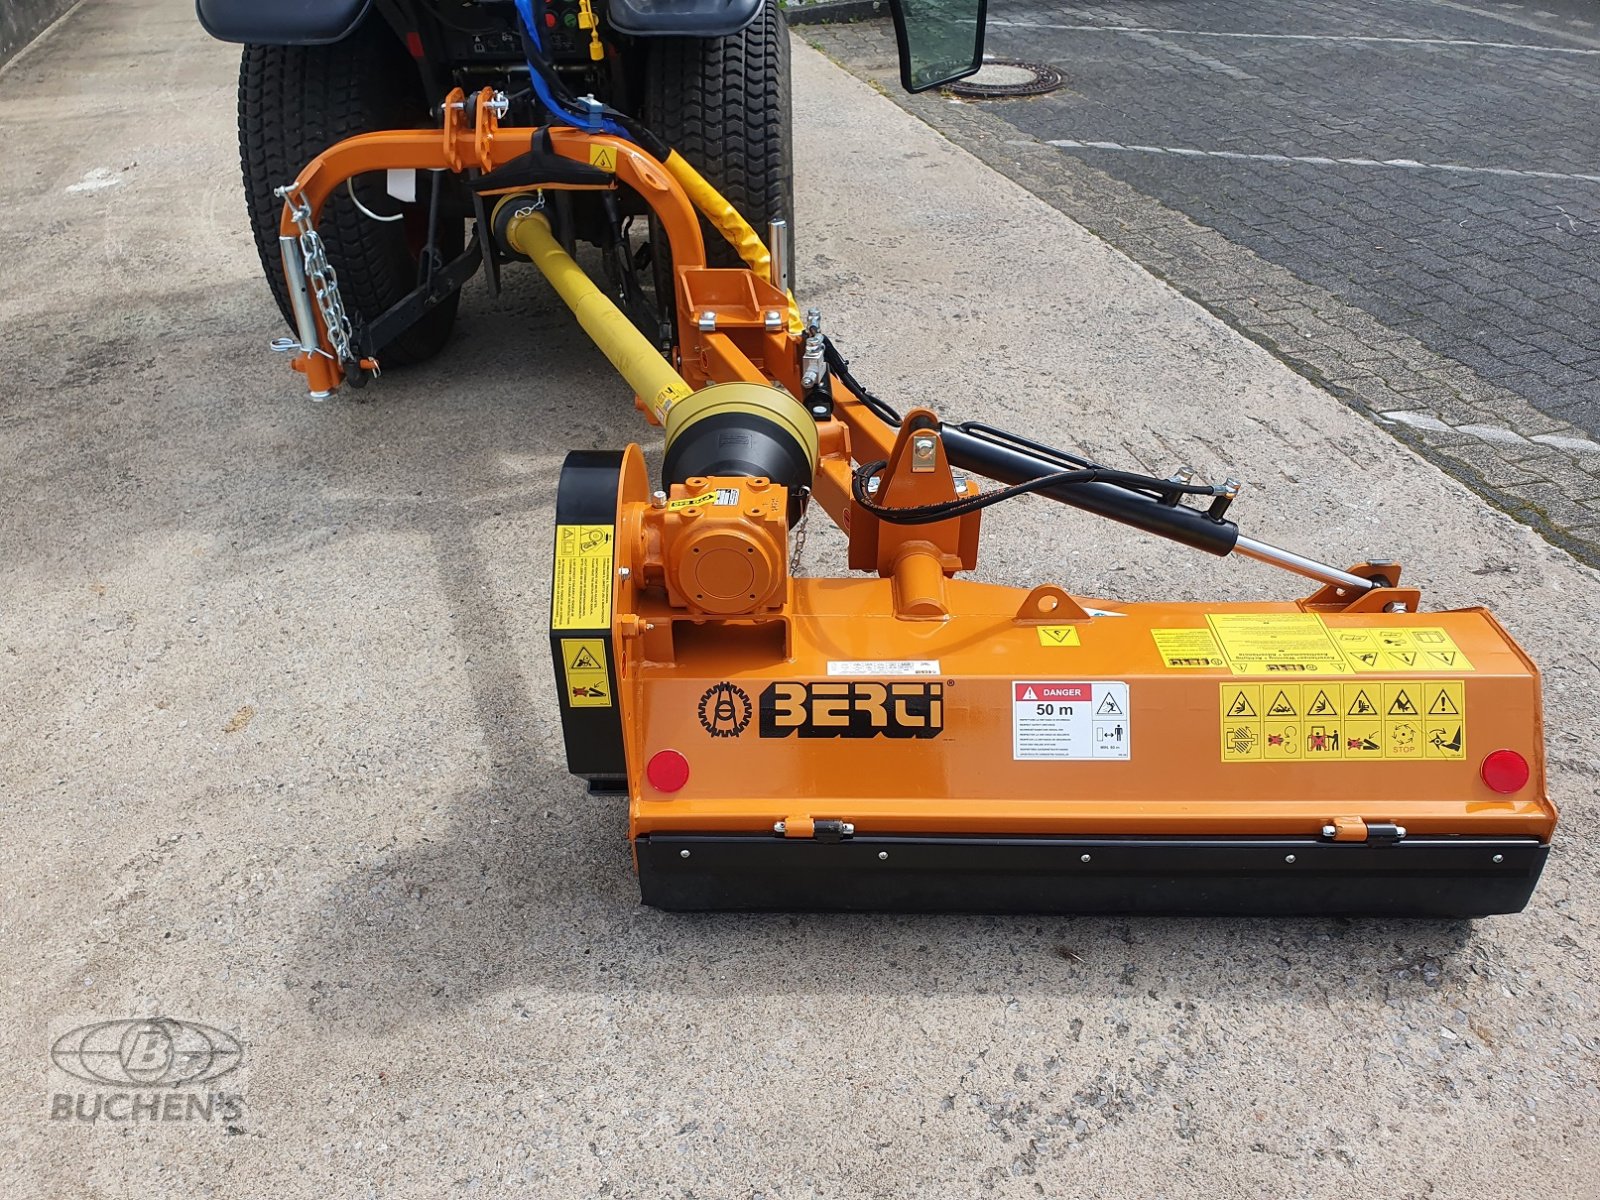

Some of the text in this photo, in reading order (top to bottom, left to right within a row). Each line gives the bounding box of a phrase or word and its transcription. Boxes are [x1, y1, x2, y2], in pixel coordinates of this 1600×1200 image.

[1043, 688, 1081, 697] DANGER
[762, 682, 944, 736] BERTI
[1036, 703, 1073, 716] 50 m
